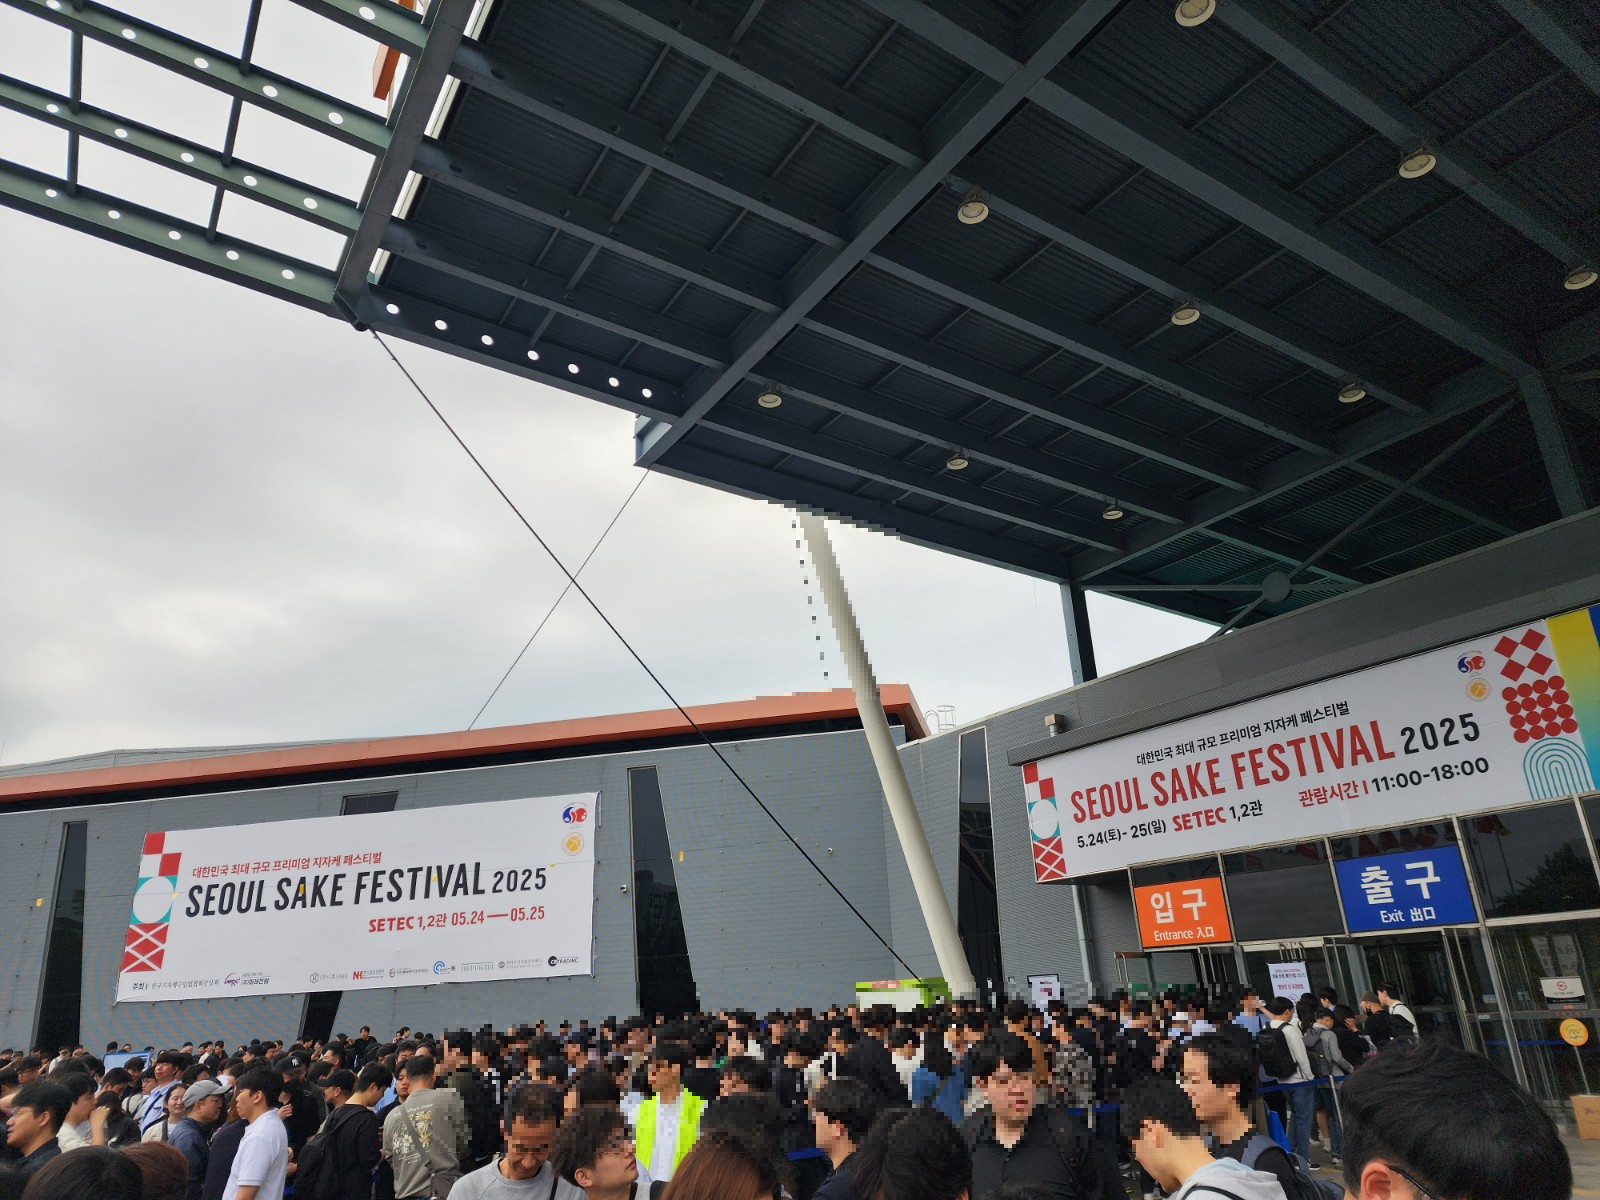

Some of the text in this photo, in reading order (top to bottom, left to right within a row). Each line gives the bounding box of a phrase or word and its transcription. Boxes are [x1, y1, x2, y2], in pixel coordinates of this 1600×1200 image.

[1136, 701, 1350, 766] 대한민국 최대 규모 프리미엄 지자케 페스티벌
[1071, 713, 1480, 824] SEOUL SAKE FESTIVAL 2025
[1299, 780, 1359, 808] 관람시간
[1371, 757, 1489, 793] 11:00-18:00
[1130, 819, 1167, 840] 25(일)
[1172, 807, 1227, 832] SETEC
[1229, 799, 1264, 822] 1,2관
[192, 851, 382, 879] 대한민국 최대 규모 프리미엄 지자케 페스티벌
[186, 862, 547, 918] SEOUL SAKE FESTIVAL 2025
[368, 916, 415, 933] SETEC
[417, 913, 447, 931] 1,2관
[1154, 927, 1215, 942] Entrance 入口
[1380, 907, 1436, 923] Exit 出口
